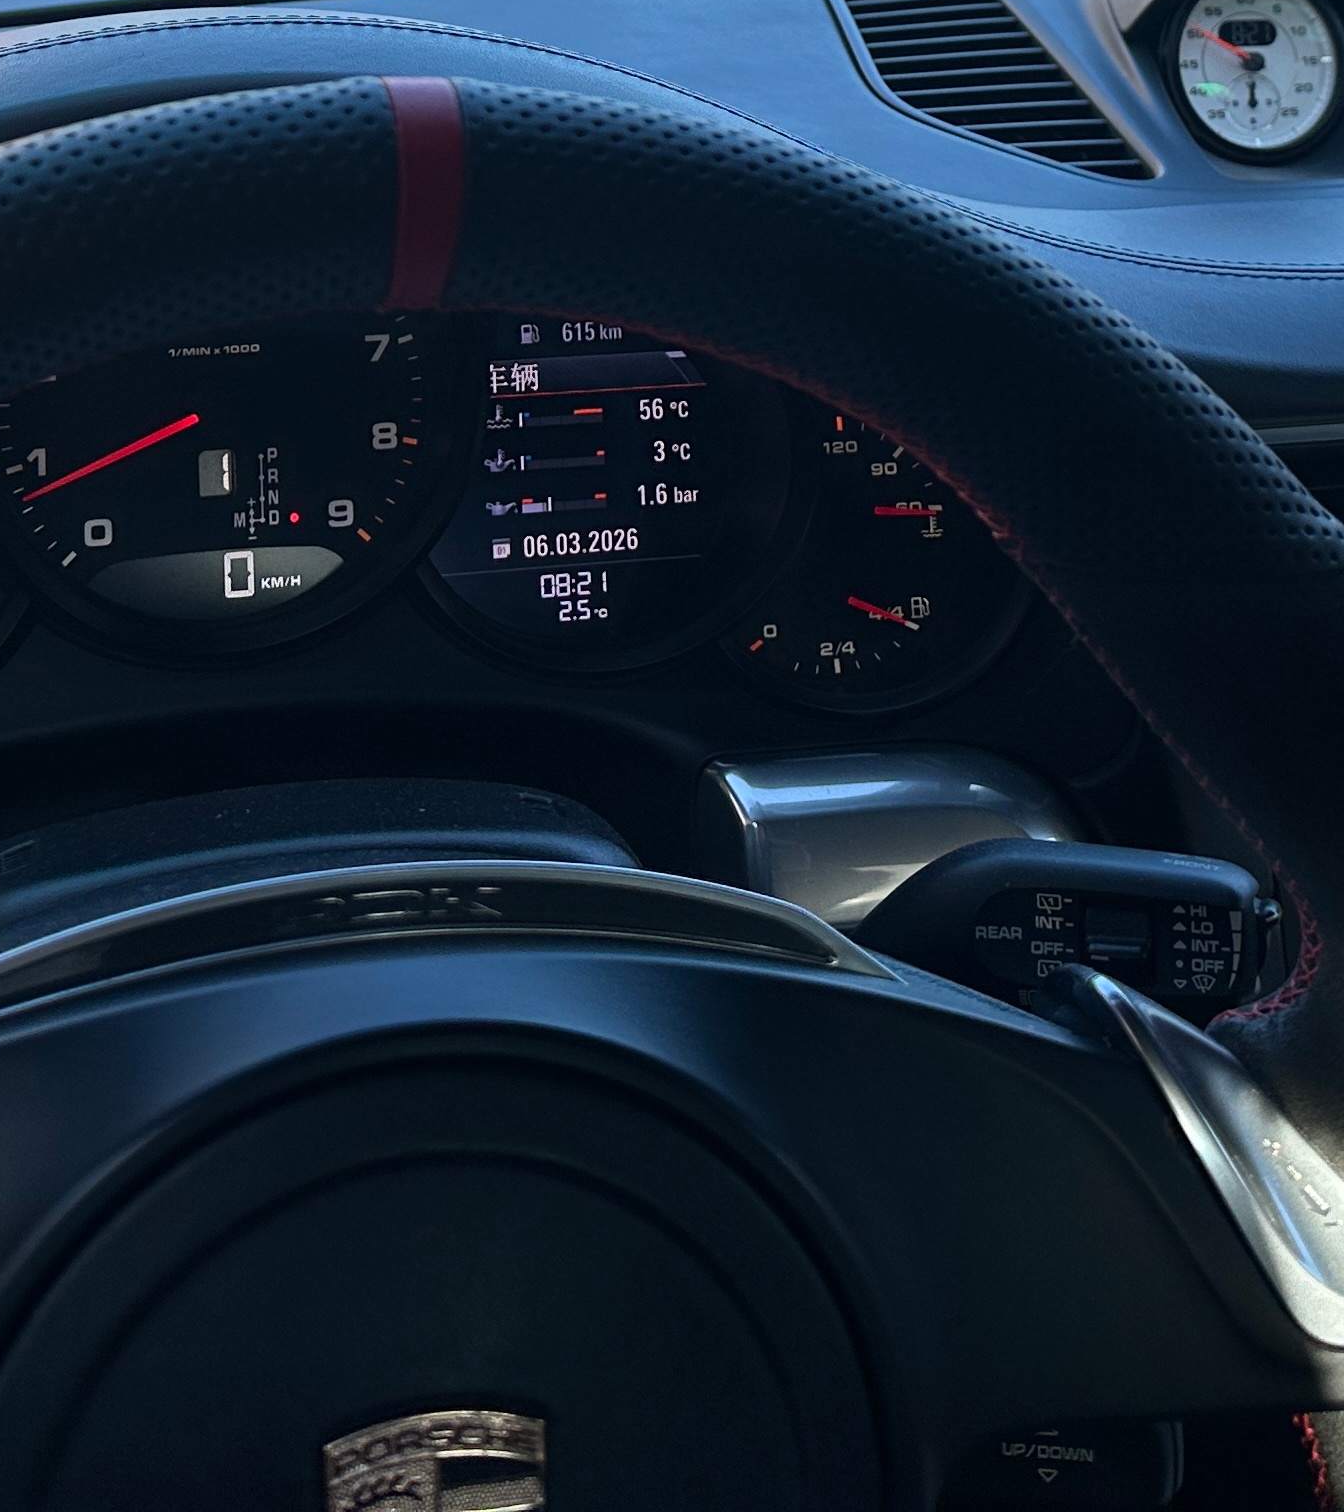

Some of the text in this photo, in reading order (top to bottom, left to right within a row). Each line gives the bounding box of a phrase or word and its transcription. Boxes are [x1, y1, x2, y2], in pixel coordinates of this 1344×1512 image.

[562, 322, 622, 342] 615 km
[168, 347, 211, 357] 1/MIN
[222, 344, 260, 354] 1000
[365, 335, 389, 361] 7
[639, 398, 664, 420] 56
[372, 423, 397, 449] 8
[267, 447, 278, 463] P
[653, 440, 665, 462] 3
[822, 440, 859, 455] 120
[26, 448, 47, 476] 1
[870, 462, 898, 476] 90
[222, 452, 230, 491] 1
[267, 468, 279, 484] R
[268, 489, 279, 505] N
[637, 483, 699, 506] 1.6 bar
[234, 512, 246, 528] M
[269, 510, 280, 525] D
[328, 500, 354, 527] 9
[85, 519, 112, 546] 0
[523, 528, 639, 558] 06.03.2026
[224, 551, 301, 598] 0 KM/H
[540, 571, 608, 599] 08:21
[559, 599, 591, 622] 2.5
[763, 624, 777, 638] 0
[820, 641, 855, 656] 2/4
[1190, 905, 1207, 918] HI
[1035, 915, 1064, 930] INT
[1191, 921, 1214, 935] LO
[975, 925, 1022, 940] REAR
[1031, 940, 1064, 956] OFF
[1191, 938, 1220, 953] INT
[1191, 958, 1225, 974] OFF
[330, 1420, 541, 1478] PORSCHE
[1001, 1442, 1094, 1462] UP/DOWN
